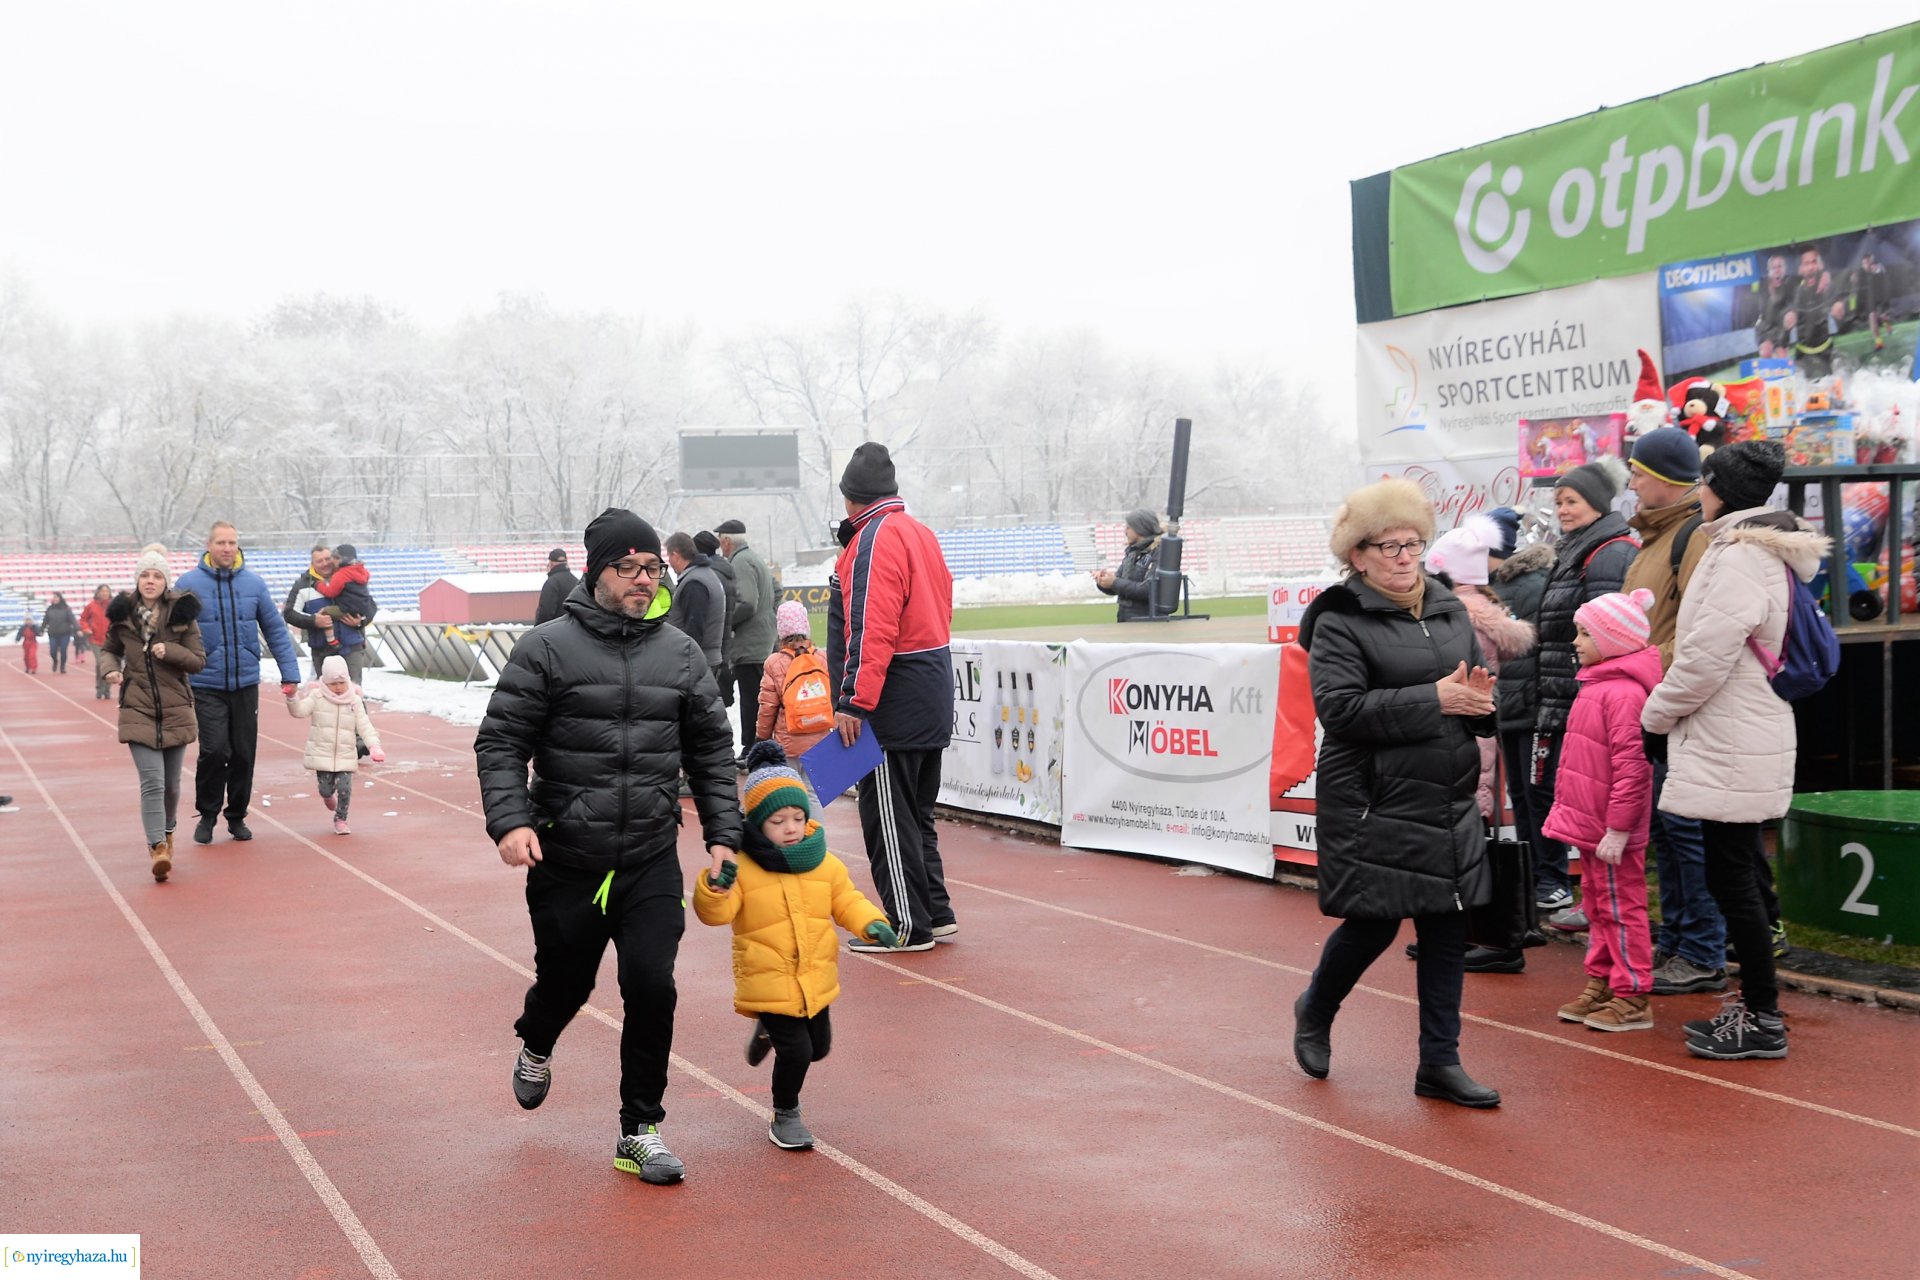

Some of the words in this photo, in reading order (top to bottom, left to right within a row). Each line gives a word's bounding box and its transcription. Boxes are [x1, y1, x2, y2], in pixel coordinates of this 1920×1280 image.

[1548, 52, 1920, 255] otpbank
[1664, 258, 1753, 289] DECATHLON
[1428, 322, 1586, 370] NYÍREGYHÁZI
[1438, 358, 1632, 408] SPORTCENTRUM
[1109, 678, 1214, 715] KONYHA
[1229, 687, 1263, 714] Kft
[1128, 720, 1218, 757] MÖBEL
[1072, 812, 1086, 821] web:
[1088, 813, 1163, 833] www.konyhamobel.hu,
[1166, 823, 1190, 835] e-mail:
[1191, 824, 1270, 845] info@konyhamobel.hu
[1111, 800, 1127, 811] 4400
[1176, 806, 1200, 819] Tünde
[1201, 809, 1208, 821] út
[1210, 810, 1227, 823] 10/A.
[1840, 842, 1879, 916] 2
